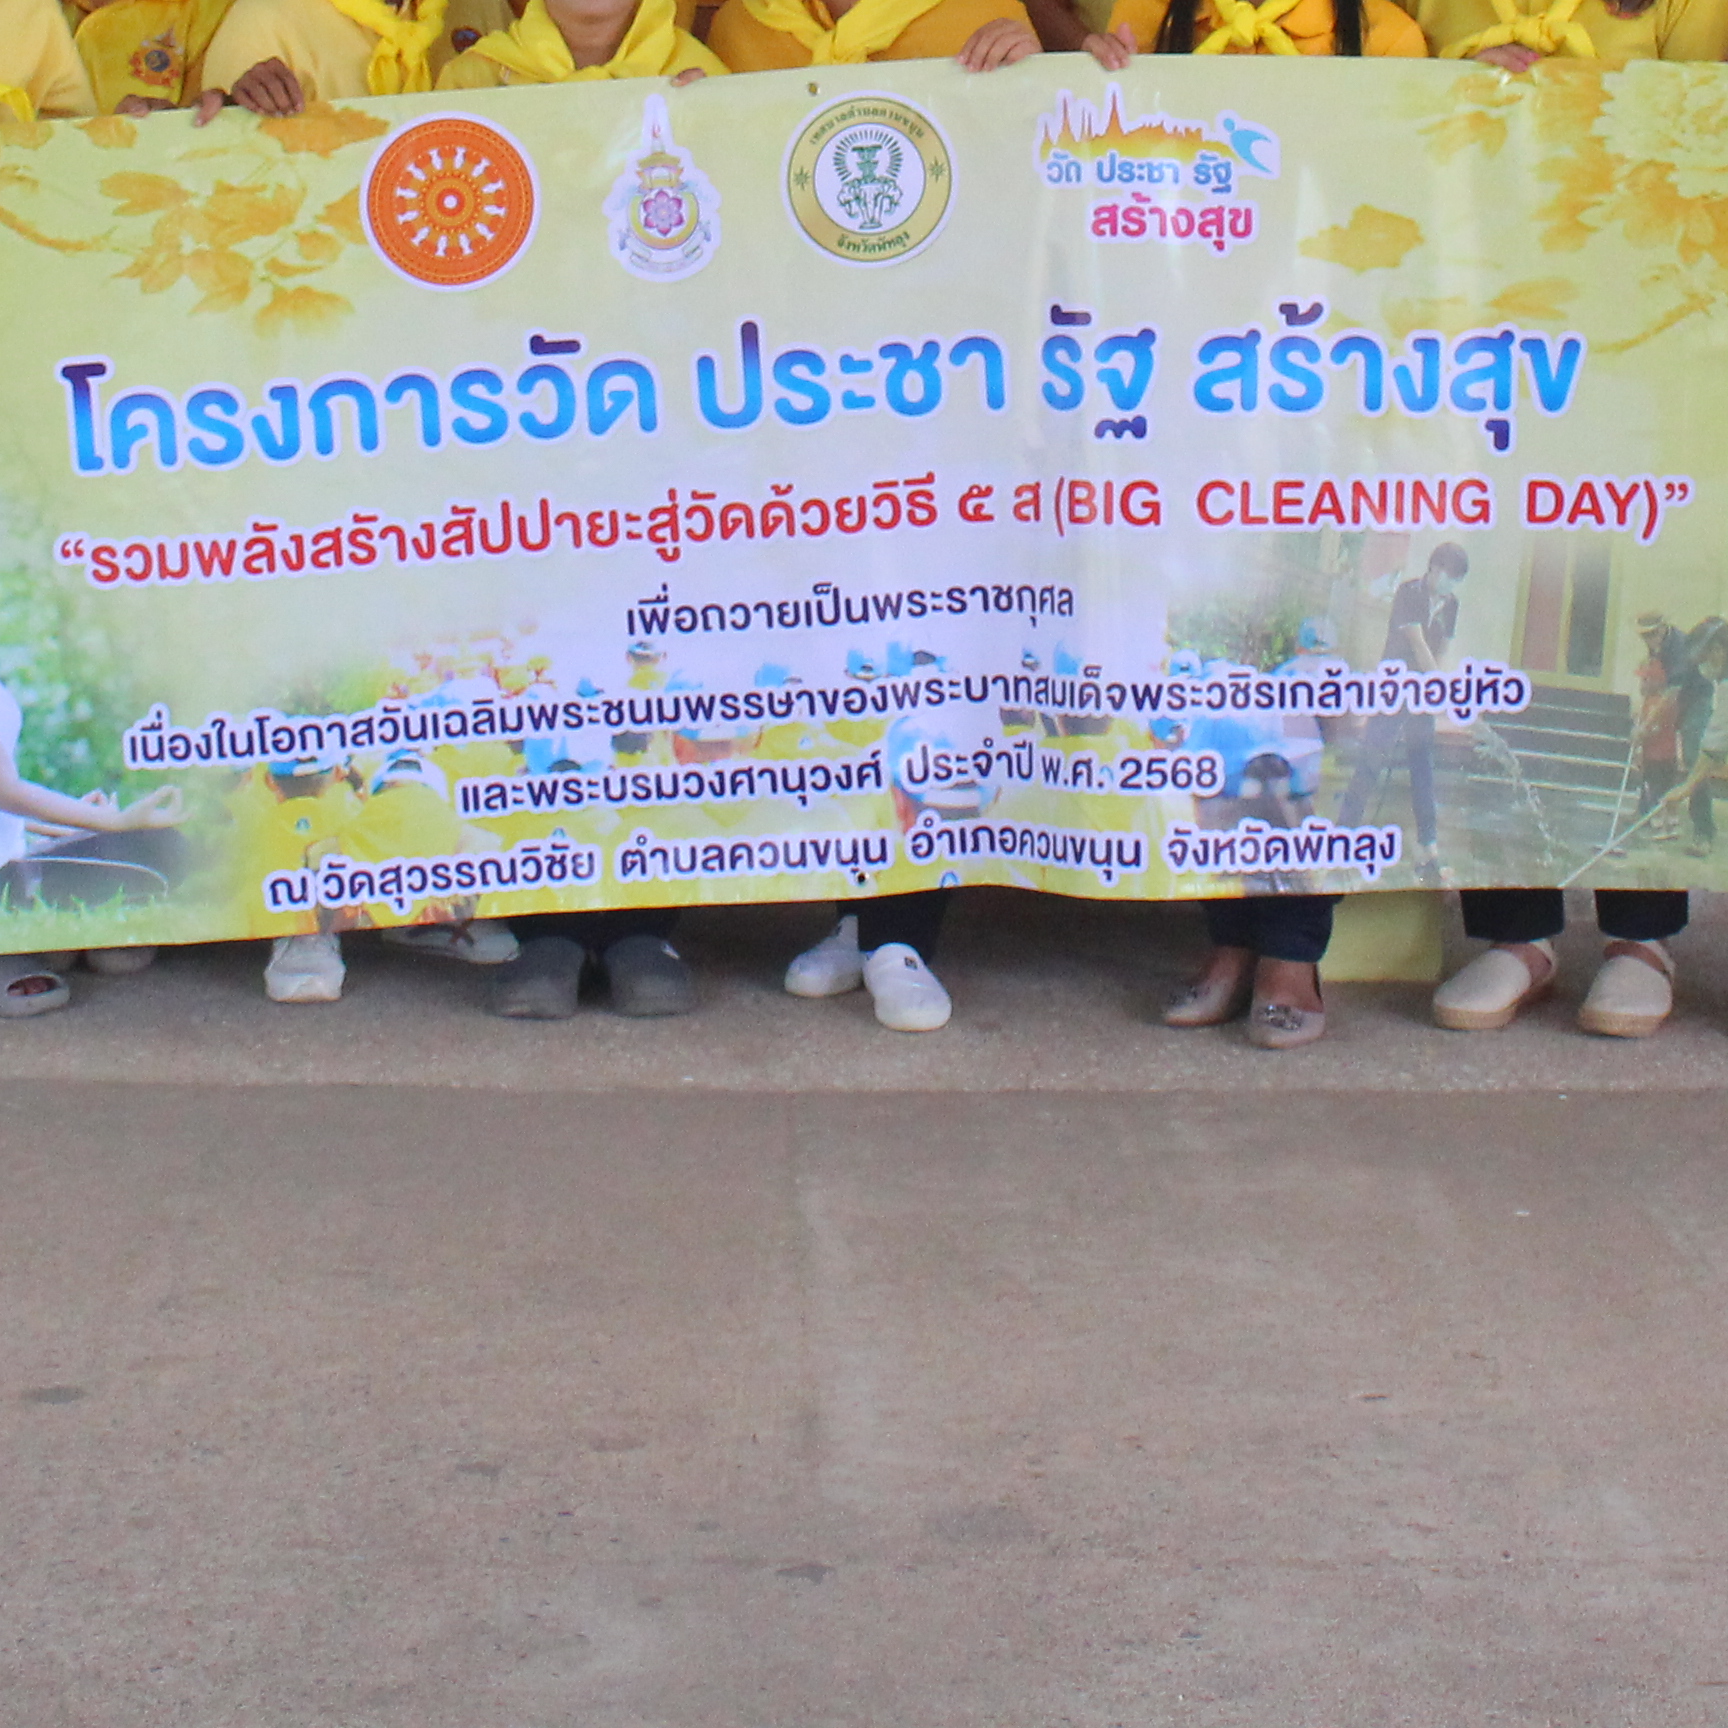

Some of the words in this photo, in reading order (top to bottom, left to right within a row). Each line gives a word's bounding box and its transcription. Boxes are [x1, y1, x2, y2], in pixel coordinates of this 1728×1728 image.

[1046, 152, 1082, 184] วัด
[1096, 151, 1181, 186] ประชา
[1192, 153, 1233, 193] รัฐ
[1091, 191, 1254, 252] สร้างสุข
[60, 334, 659, 472] โครงการวัด
[694, 321, 1007, 430] ประชา
[1040, 304, 1158, 440] รัฐ
[1192, 303, 1583, 452] สร้างสุข
[60, 472, 939, 584] “รวมพลังสร้างสัปปายะสู่วัดด้วยวิธี
[958, 484, 995, 523] ๕
[1196, 479, 1491, 527] CLEANING
[626, 582, 1074, 635] เพื่อถวายเป็นพระราชกุศล
[129, 664, 1526, 763] เนื่องในโอกาสวันเฉลิมพระชนมพรรษาของพระบาทสมเด็จพระวชิรเกล้าเจ้าอยู่หัว
[461, 750, 883, 813] และพระบรมวงศานุวงศ์
[906, 737, 1034, 786] ประจำปี
[1041, 756, 1105, 789] พ.ศ.
[1119, 757, 1218, 790] 2568
[323, 843, 595, 909] วัดสุวรรณวิชัย
[620, 836, 888, 884] ตำบลควนขนุน
[910, 824, 1141, 882] อำเภอควนขนุน
[1168, 824, 1396, 877] จังหวัดพัทลุง
